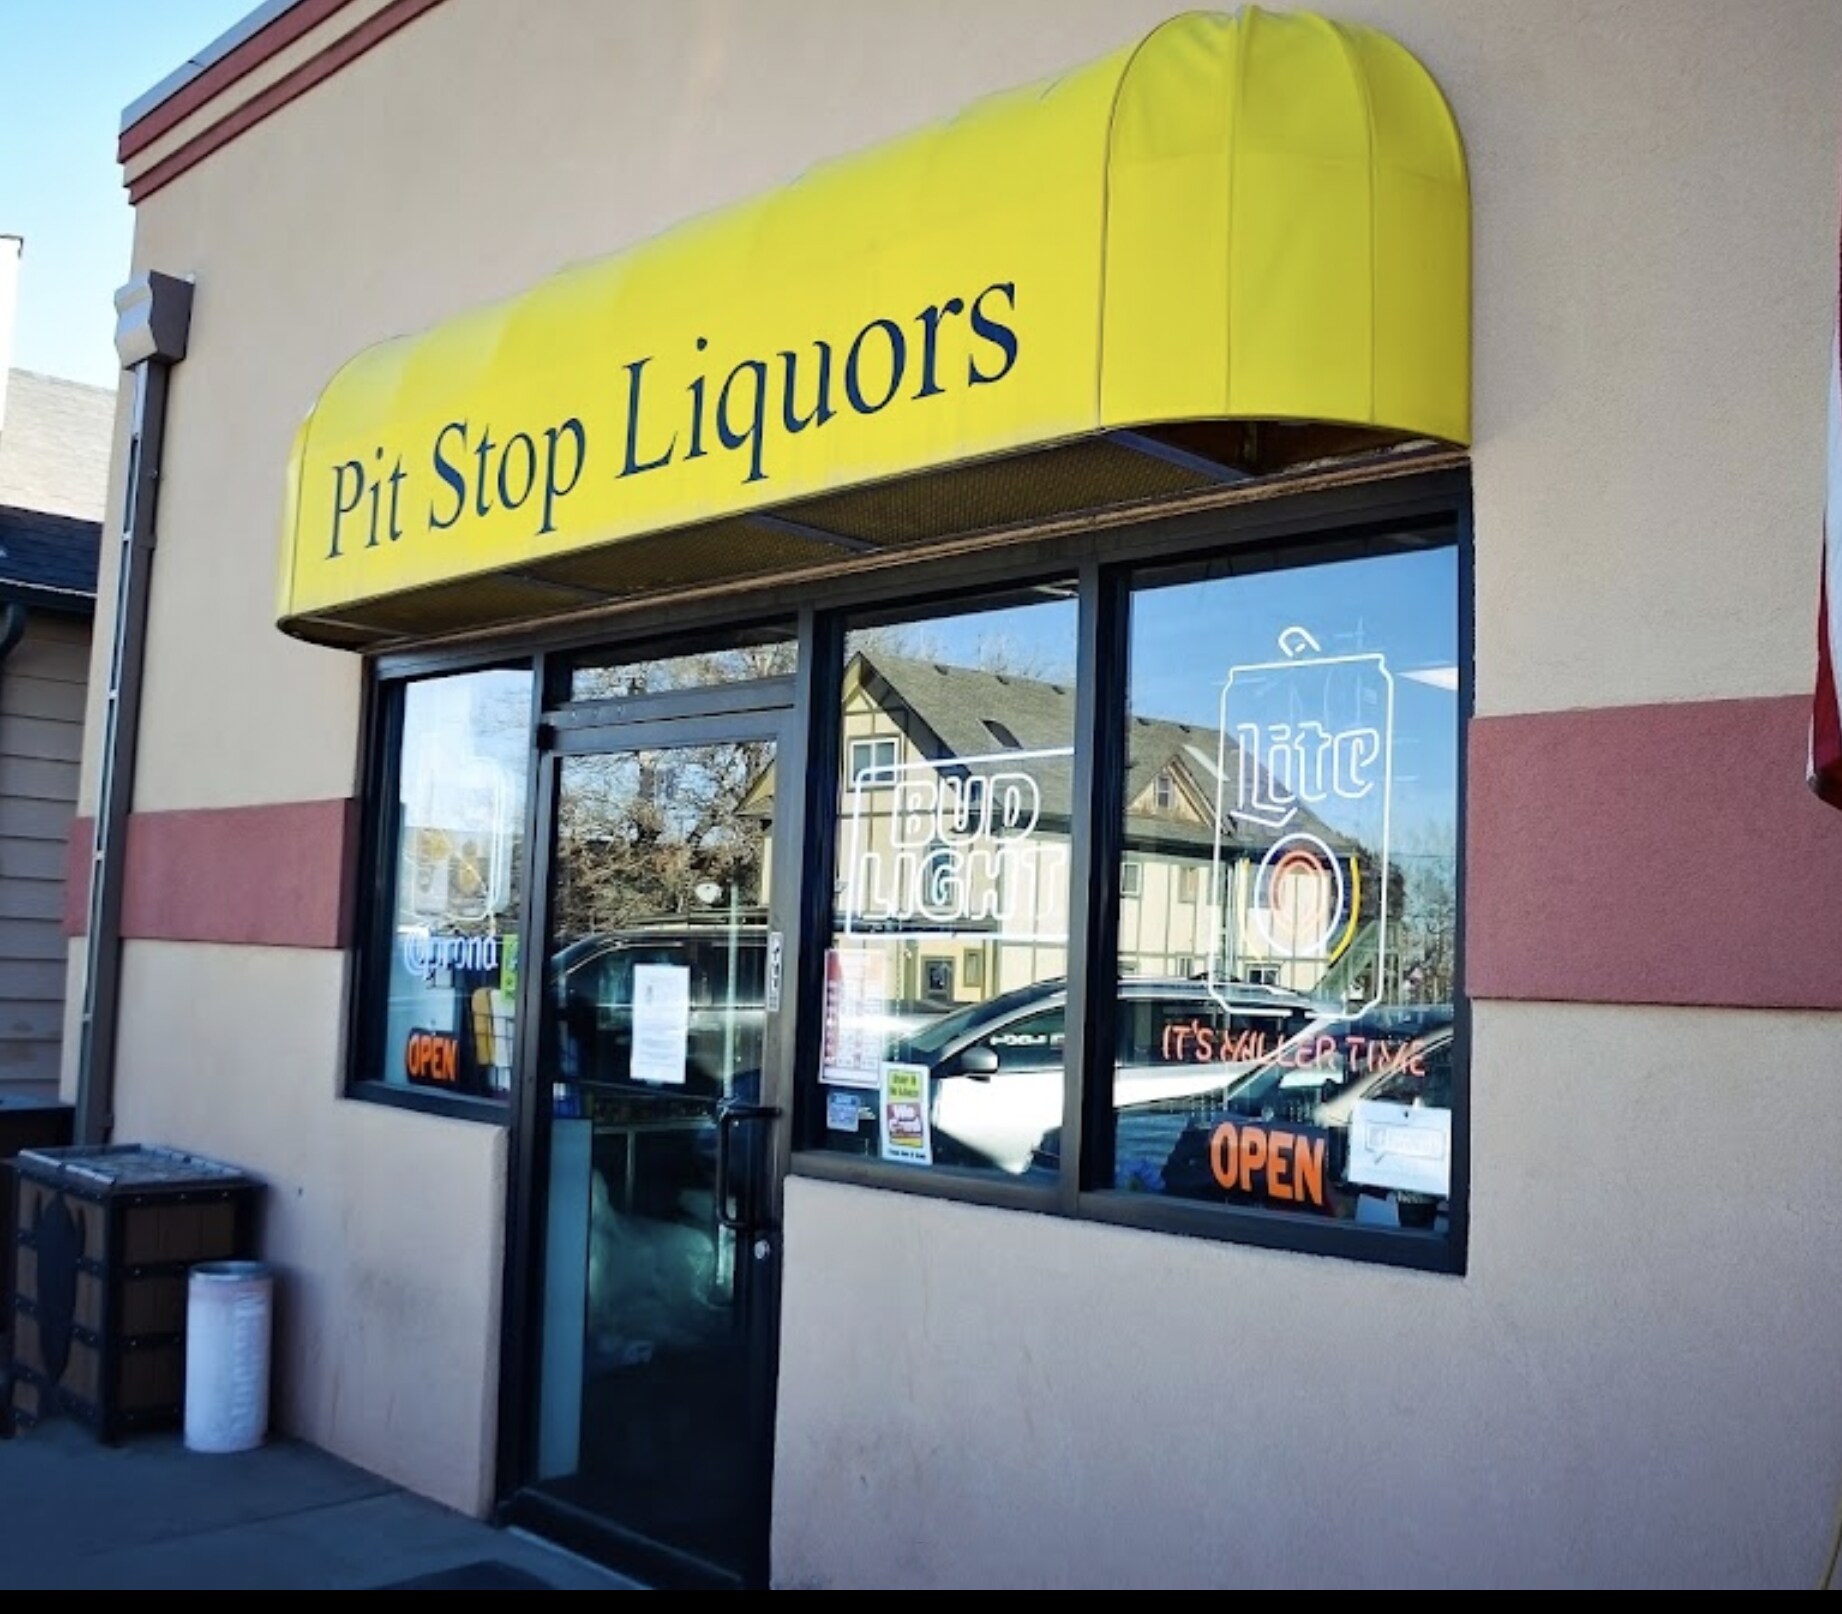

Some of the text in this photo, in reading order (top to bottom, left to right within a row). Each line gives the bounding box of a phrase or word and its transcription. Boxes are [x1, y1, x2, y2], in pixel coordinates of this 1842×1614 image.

[325, 281, 1019, 561] Pit Stop Liquors
[890, 772, 1040, 848] BUD
[1229, 720, 1380, 828] Lite
[857, 845, 1070, 922] LIGHT
[404, 933, 499, 981] Corona
[408, 1033, 459, 1082] OPEN
[1162, 1019, 1426, 1077] IT'S MILLER TIME
[1210, 1121, 1325, 1206] OPEN
